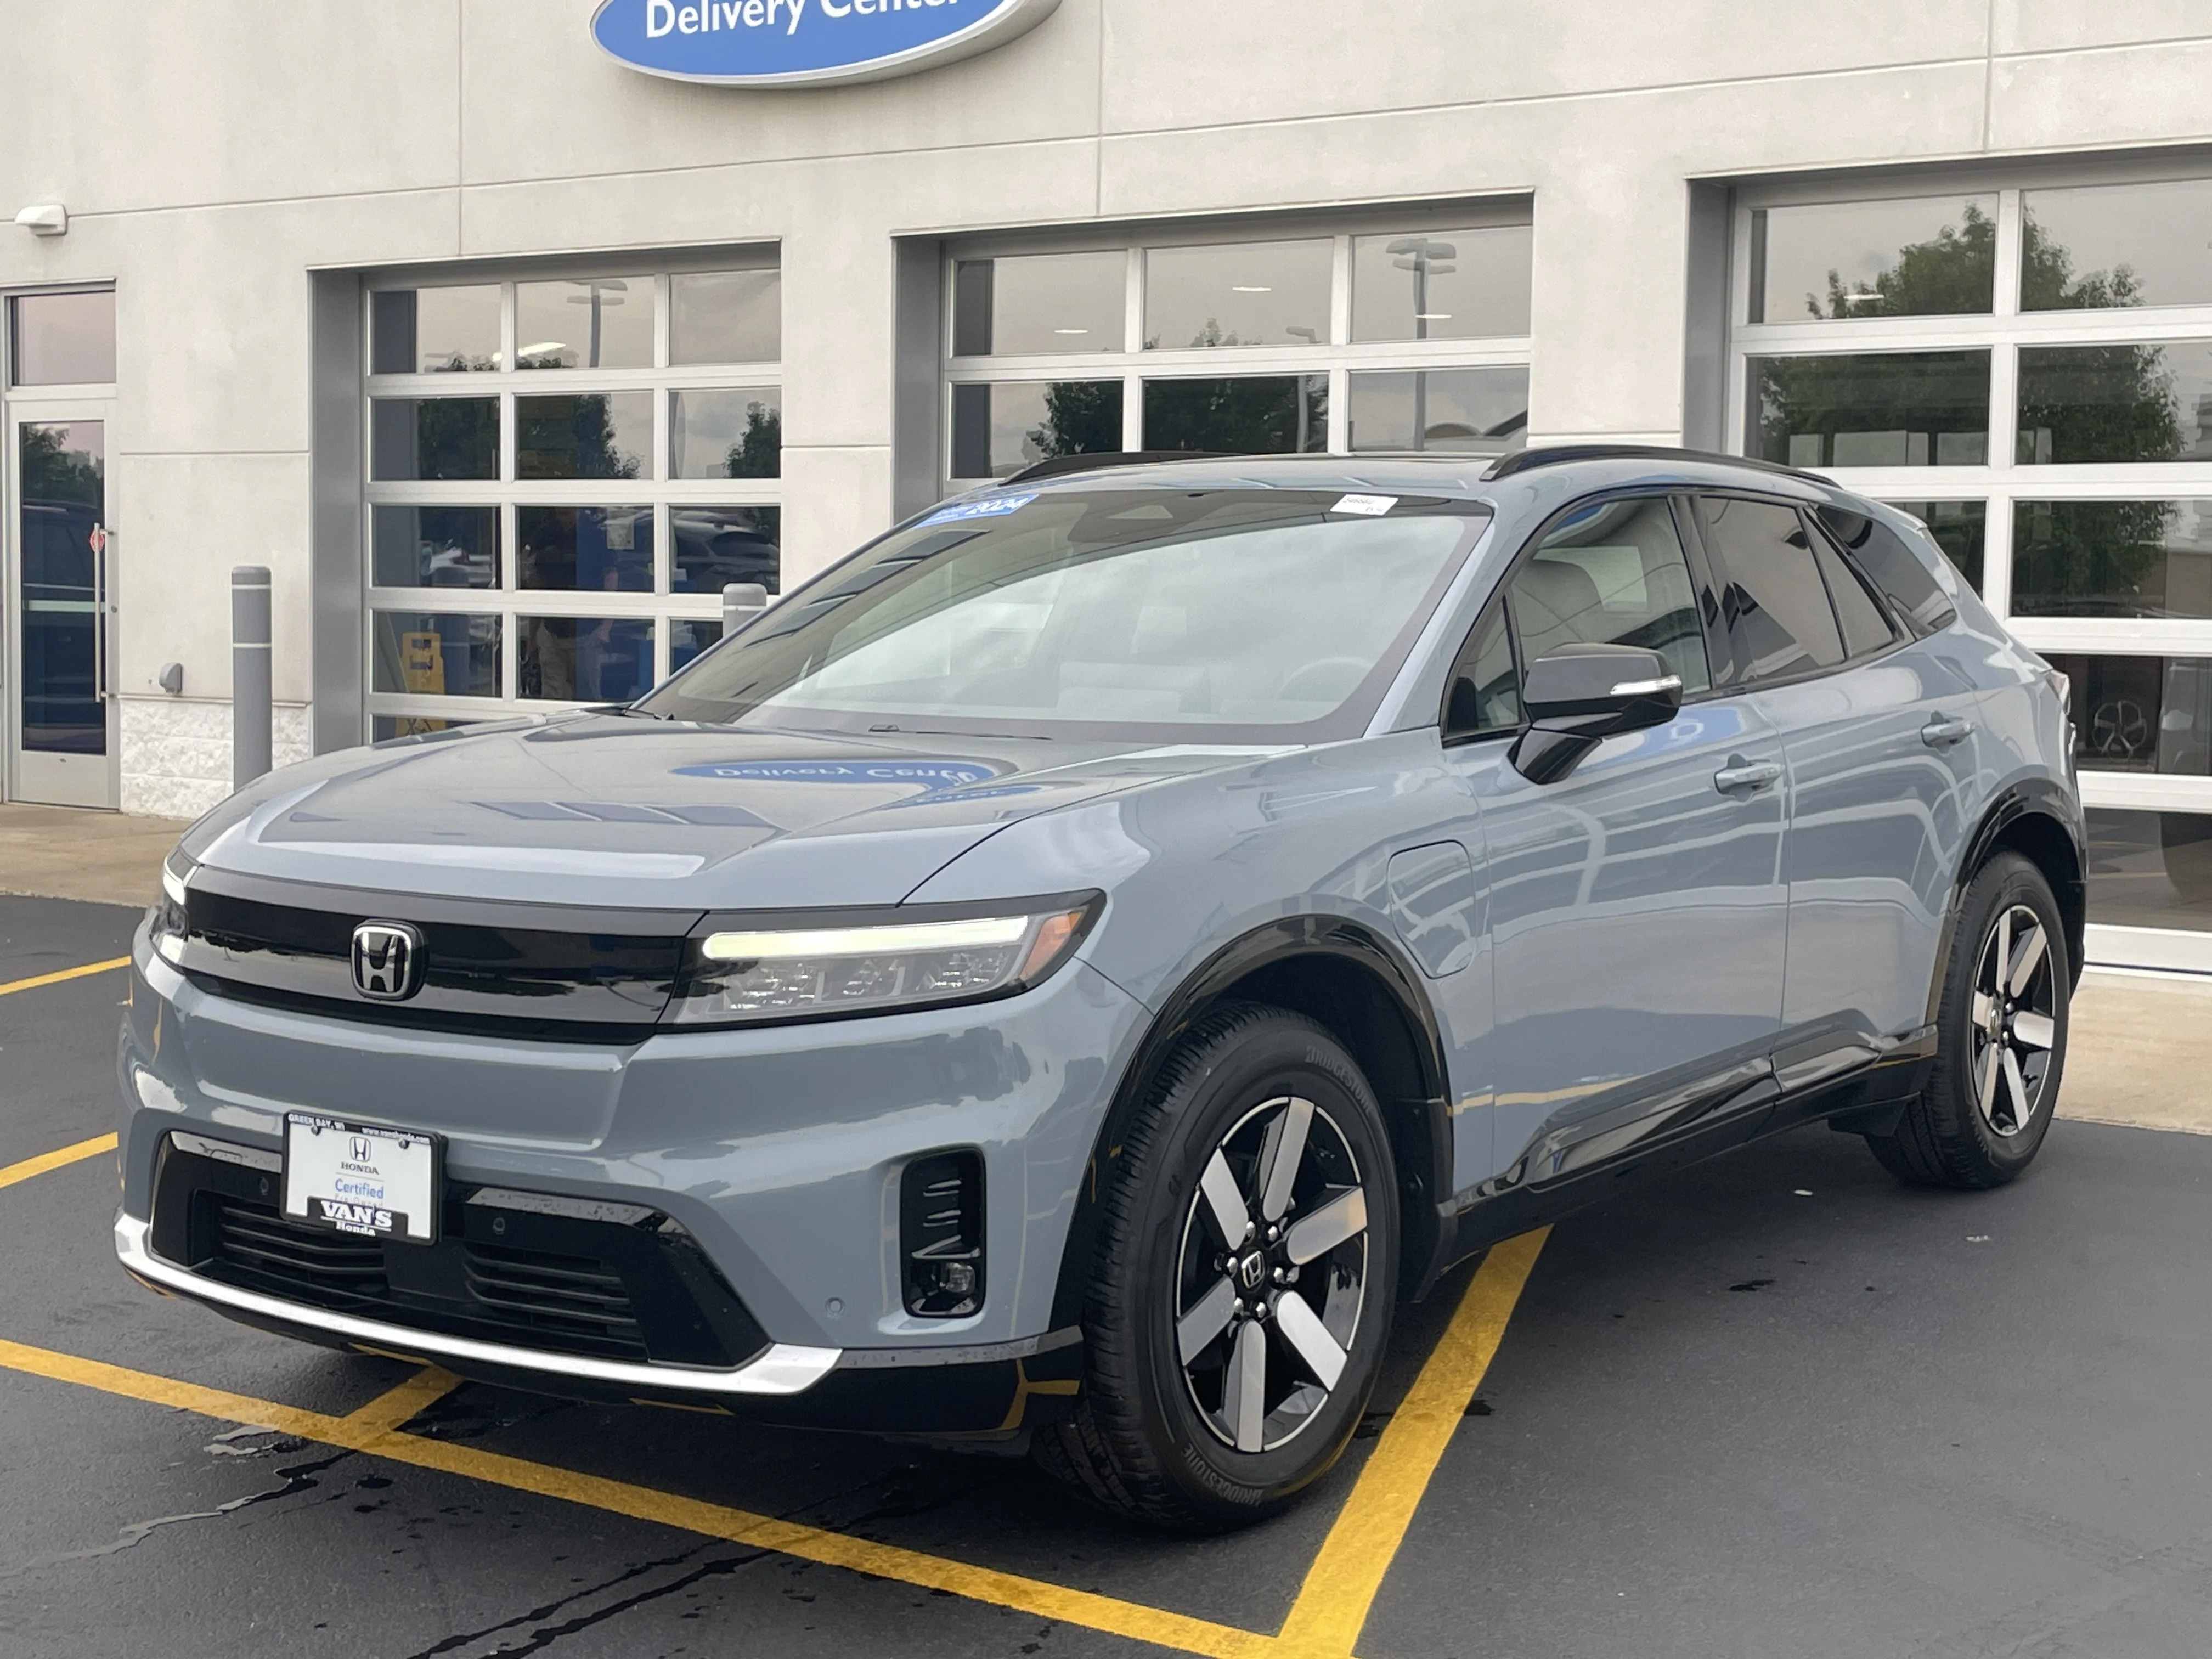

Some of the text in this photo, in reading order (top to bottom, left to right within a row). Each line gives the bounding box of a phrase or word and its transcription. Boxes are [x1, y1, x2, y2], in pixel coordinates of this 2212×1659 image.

[646, 0, 805, 38] Delivery
[1305, 1045, 1374, 1118] BRIDGESTONE
[340, 1161, 380, 1175] HONDA
[335, 1178, 384, 1199] Certified
[335, 1221, 376, 1237] Honda
